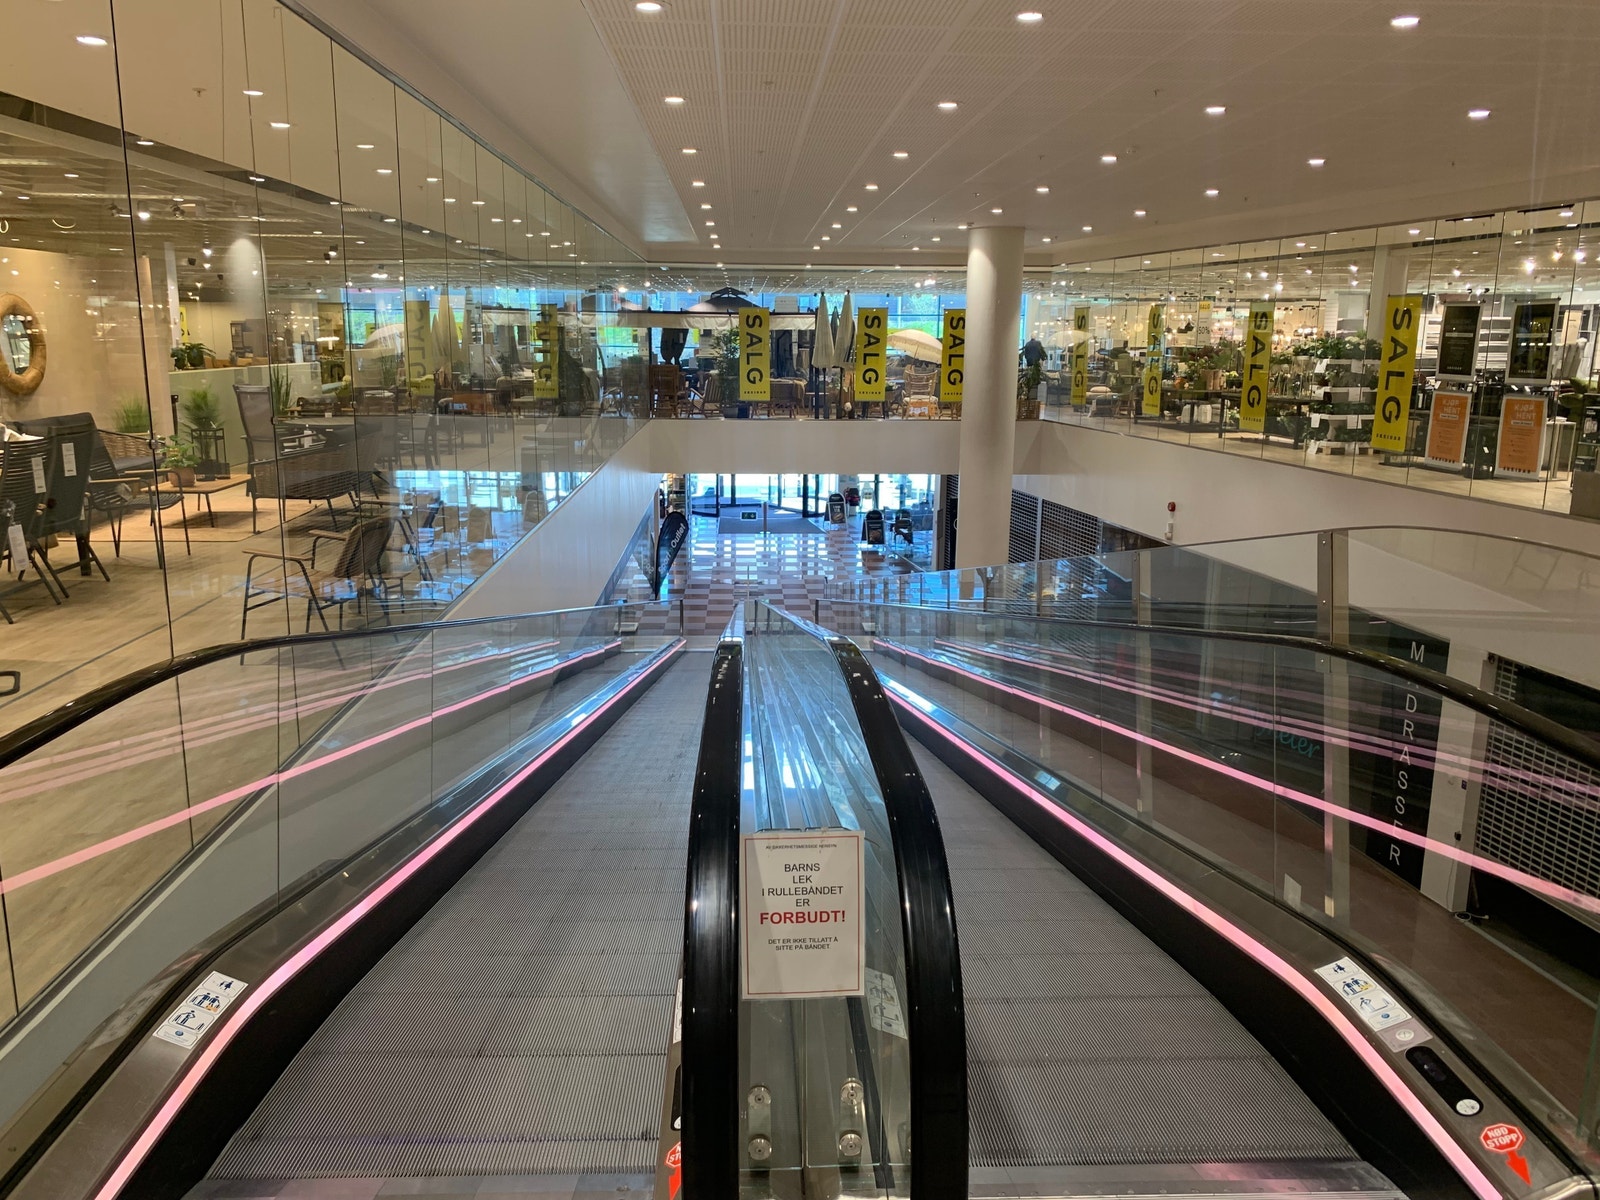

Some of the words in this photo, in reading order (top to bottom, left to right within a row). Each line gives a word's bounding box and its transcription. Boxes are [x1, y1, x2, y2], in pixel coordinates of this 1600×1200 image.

[745, 314, 763, 385] SALG
[861, 314, 882, 385] SALG
[947, 316, 966, 386] SALG
[1247, 311, 1268, 408] SALG
[1382, 307, 1412, 424] SALG
[1443, 406, 1461, 414] HENT
[1515, 411, 1536, 420] HENT
[670, 522, 687, 548] Outlet
[1388, 641, 1425, 866] MDRASSER
[784, 862, 821, 873] BARNS
[792, 875, 813, 884] LEK
[761, 888, 765, 897] I
[767, 885, 844, 897] RULLEBÅNDET
[795, 898, 811, 907] ER
[759, 910, 846, 925] FORBUDT!
[1486, 1126, 1509, 1139] NØD
[1486, 1133, 1518, 1149] STOPP
